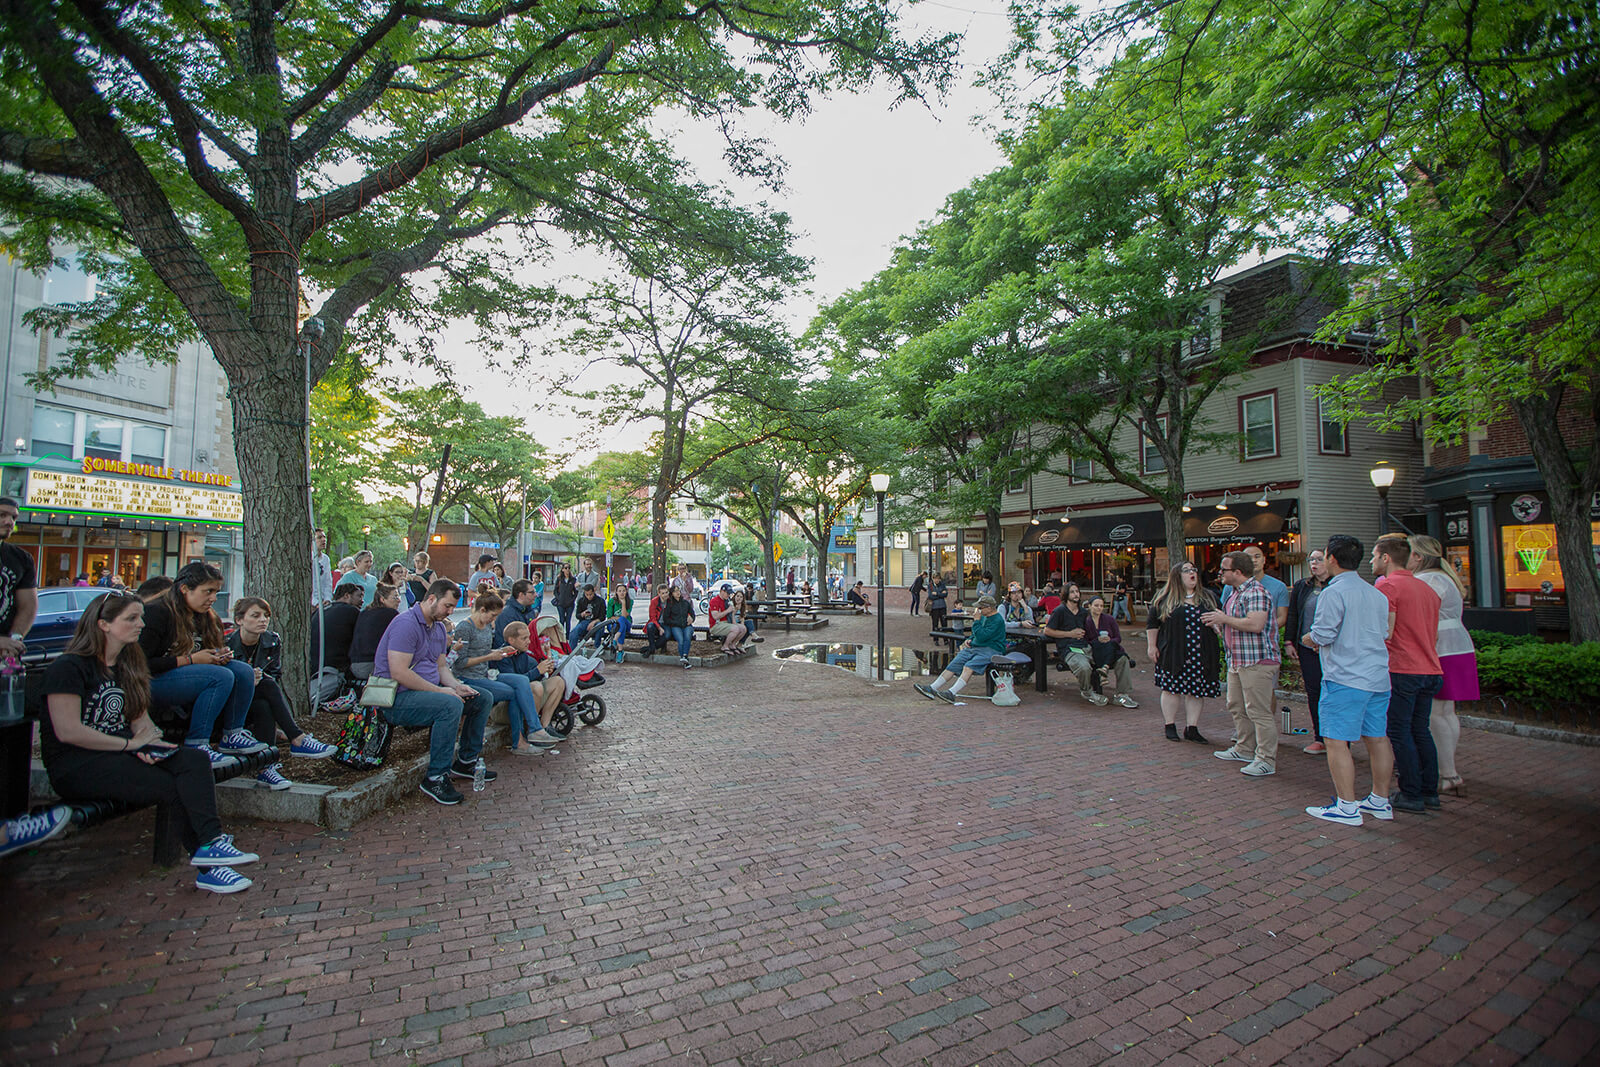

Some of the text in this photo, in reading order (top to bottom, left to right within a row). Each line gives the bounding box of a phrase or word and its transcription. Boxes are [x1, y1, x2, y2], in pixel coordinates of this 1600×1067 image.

[82, 456, 232, 487] SOMERVILLE THEATRE
[33, 472, 62, 482] COMING
[66, 475, 86, 484] SOON
[160, 486, 184, 494] PROJECT
[80, 484, 122, 495] MIDNIGHTS
[62, 491, 87, 499] DOUBLE
[92, 494, 122, 502] FEATURES
[54, 498, 83, 507] PLAYING
